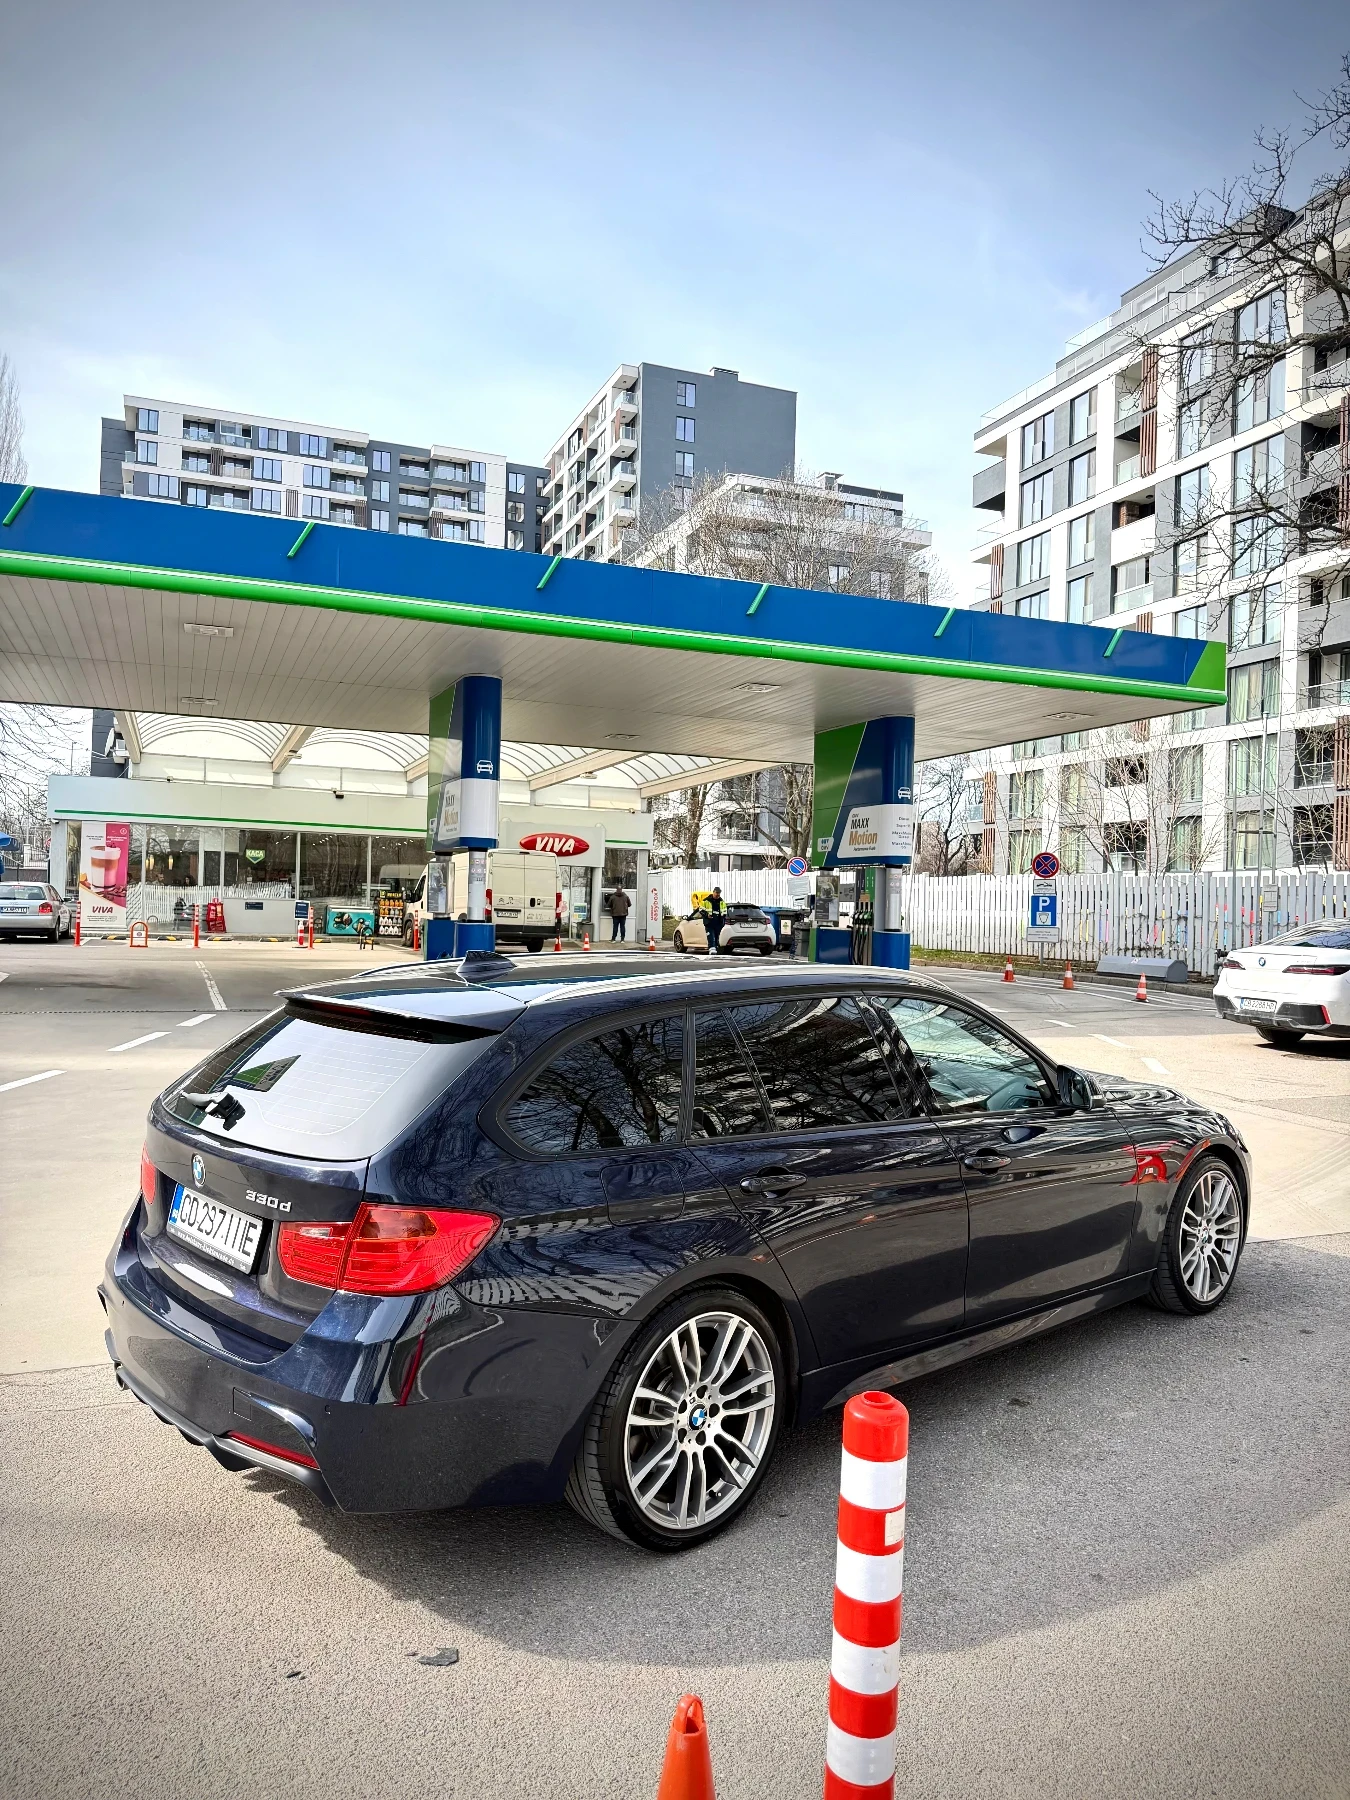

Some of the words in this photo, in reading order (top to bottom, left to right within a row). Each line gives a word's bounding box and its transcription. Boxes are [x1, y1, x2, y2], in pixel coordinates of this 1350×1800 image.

[850, 818, 870, 830] MAXX
[535, 836, 576, 853] VIVA
[848, 830, 878, 846] Motion
[92, 906, 114, 914] VIVA
[1038, 896, 1051, 912] P
[245, 1189, 292, 1213] 330d
